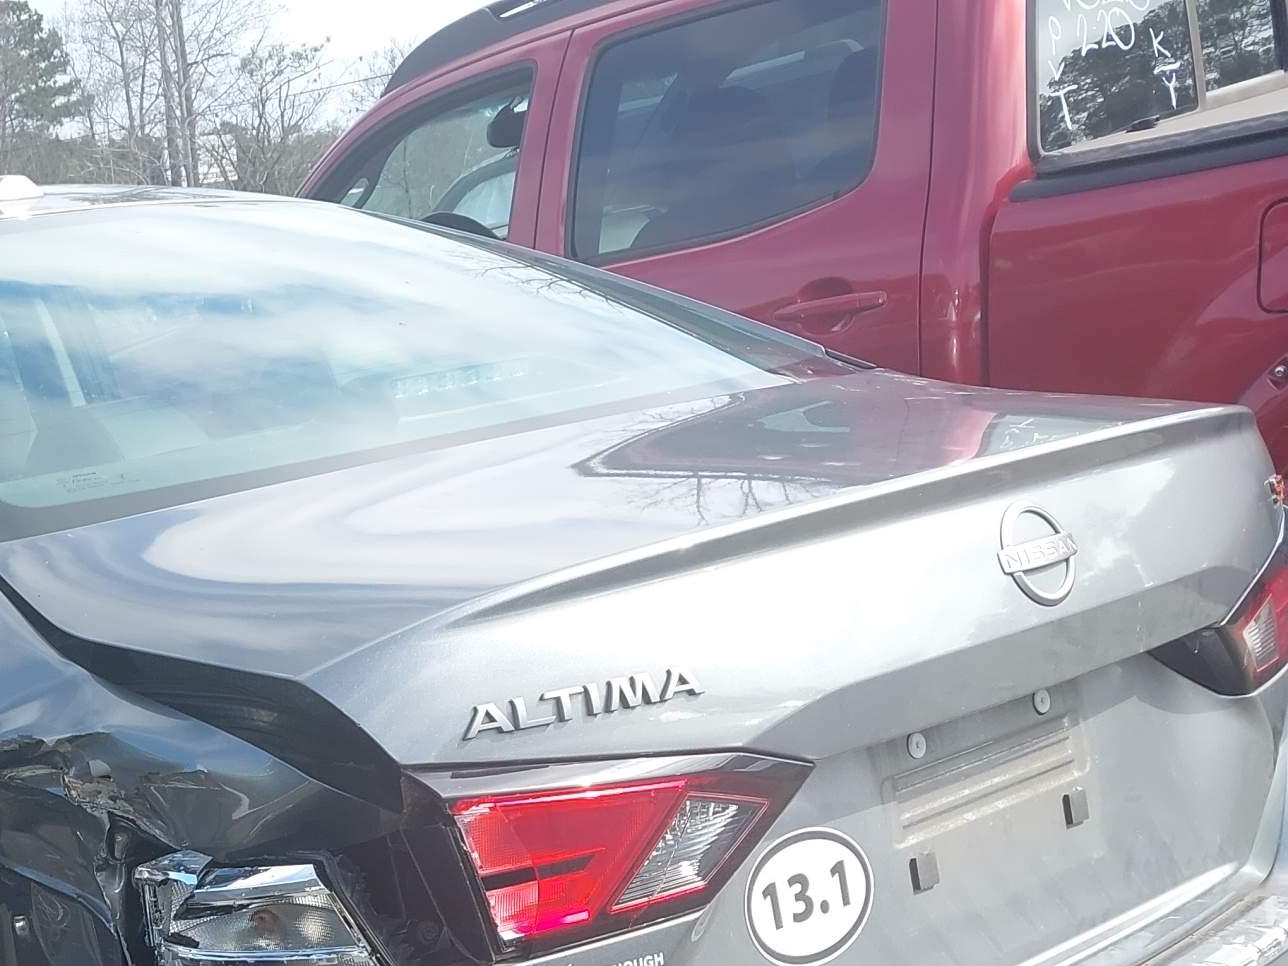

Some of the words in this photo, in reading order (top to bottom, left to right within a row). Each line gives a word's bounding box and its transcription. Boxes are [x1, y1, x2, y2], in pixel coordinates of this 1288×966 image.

[1004, 537, 1077, 569] NISSAN
[464, 667, 704, 741] ALTIMA
[761, 859, 852, 931] 13.1
